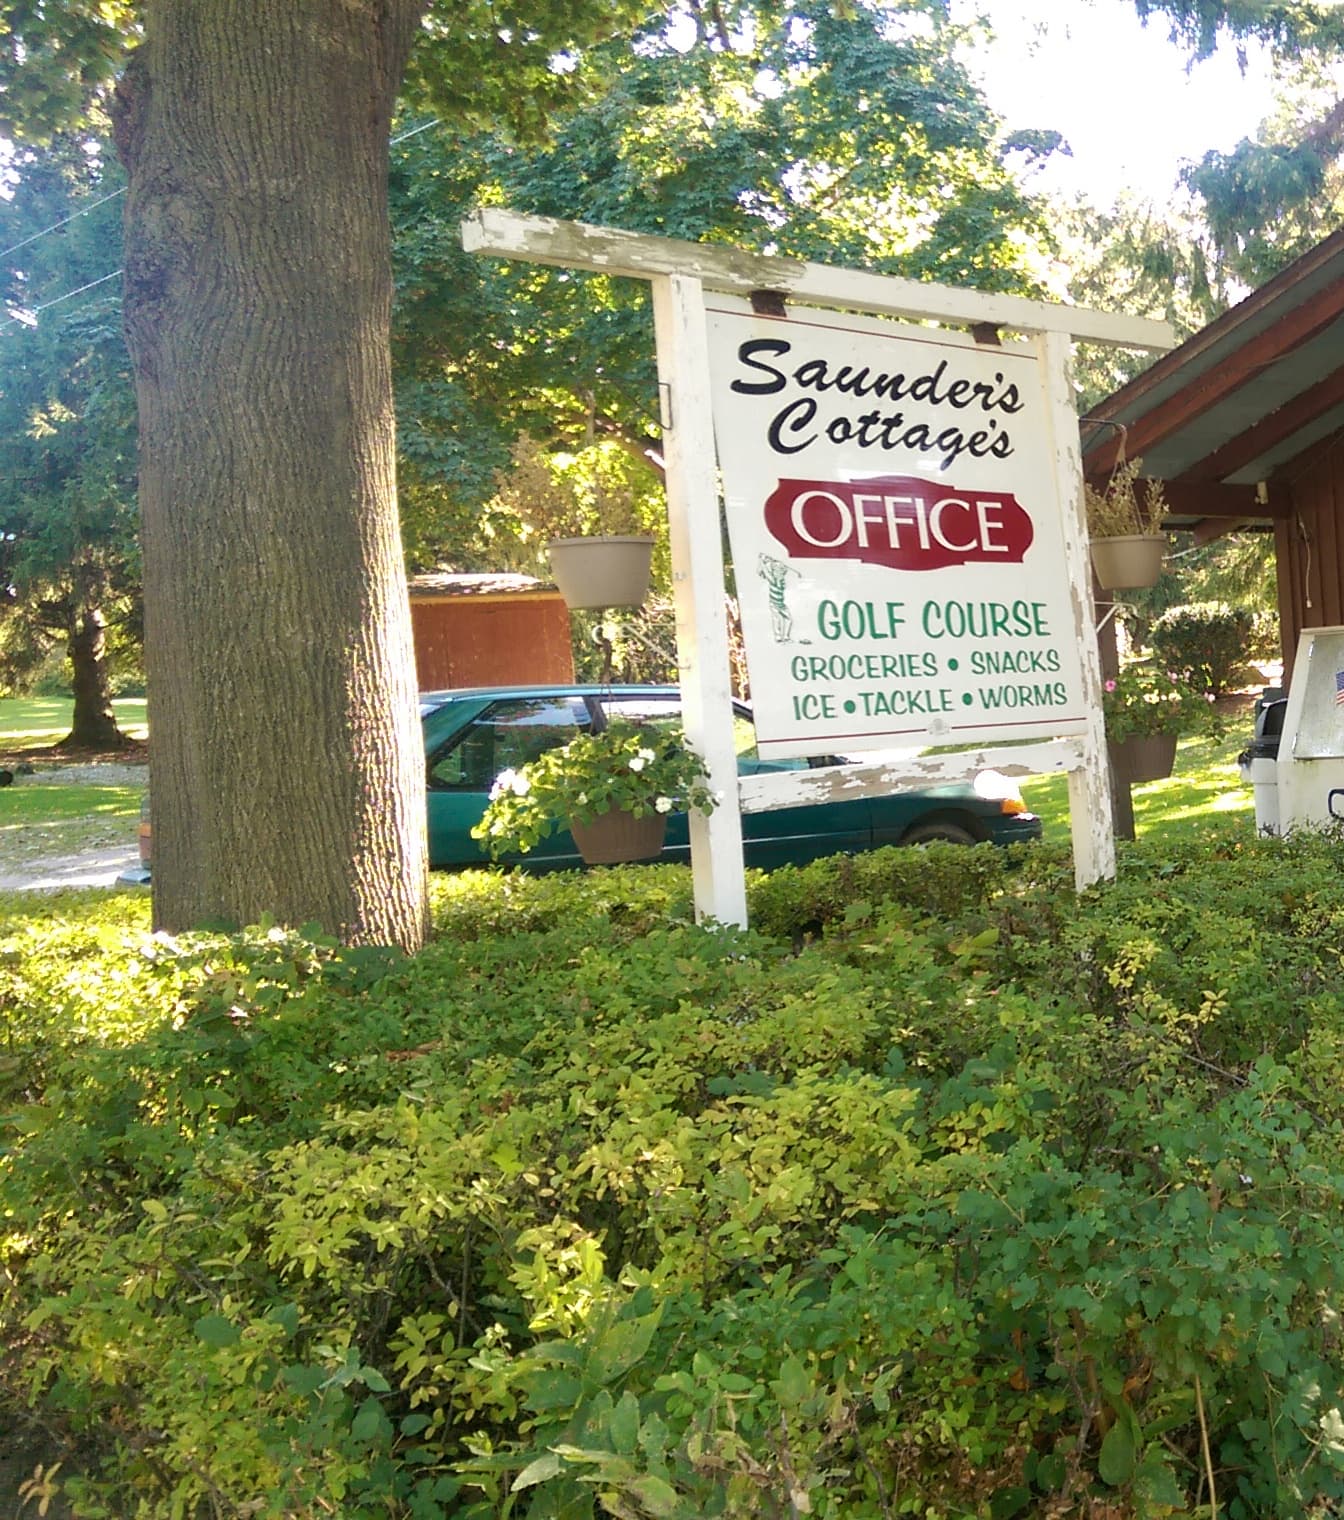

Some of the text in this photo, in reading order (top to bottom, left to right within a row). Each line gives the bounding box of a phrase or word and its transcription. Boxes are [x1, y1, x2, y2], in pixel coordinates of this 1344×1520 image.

[730, 337, 1025, 414] Saunder's
[767, 396, 1014, 471] Cottage's
[790, 490, 1009, 552] OFFICE
[817, 599, 1052, 641] GOLF COURSE
[791, 649, 1061, 682] GROCERIES SNACKS
[792, 682, 1068, 721] ICE TACKLE WORMS
